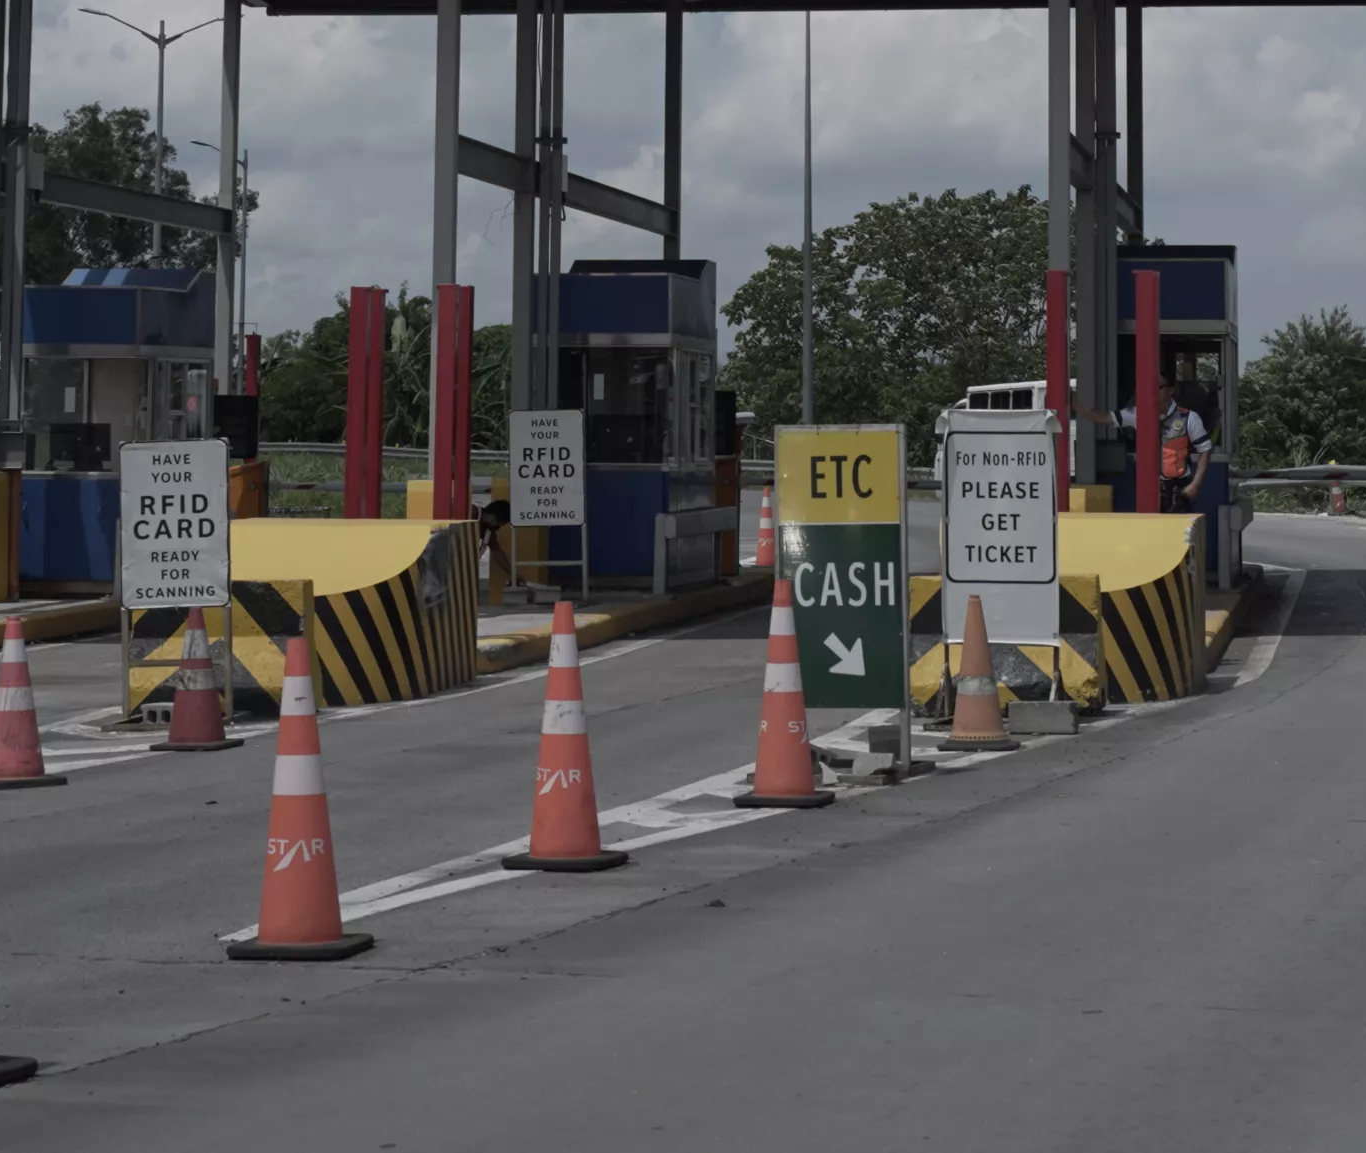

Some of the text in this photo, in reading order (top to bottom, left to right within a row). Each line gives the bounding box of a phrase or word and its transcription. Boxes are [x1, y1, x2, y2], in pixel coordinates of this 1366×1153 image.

[530, 418, 559, 427] HAVE
[530, 431, 560, 440] YOUR
[152, 453, 191, 466] HAVE
[522, 446, 571, 462] RFID
[955, 450, 1047, 467] For Non-RFID
[150, 471, 193, 484] YOUR
[517, 463, 576, 479] CARD
[809, 453, 874, 499] ETC
[530, 486, 565, 496] READY
[961, 480, 1041, 500] PLEASE
[139, 493, 209, 516] RFID
[537, 498, 558, 508] FOR
[519, 510, 576, 521] SCANNING
[980, 513, 1022, 532] GET
[133, 517, 216, 540] CARD
[150, 550, 200, 563] READY
[964, 544, 1038, 564] TICKET
[160, 568, 191, 581] FOR
[135, 585, 216, 599] SCANNING
[794, 560, 896, 608] CASH
[267, 837, 325, 873] STAR
